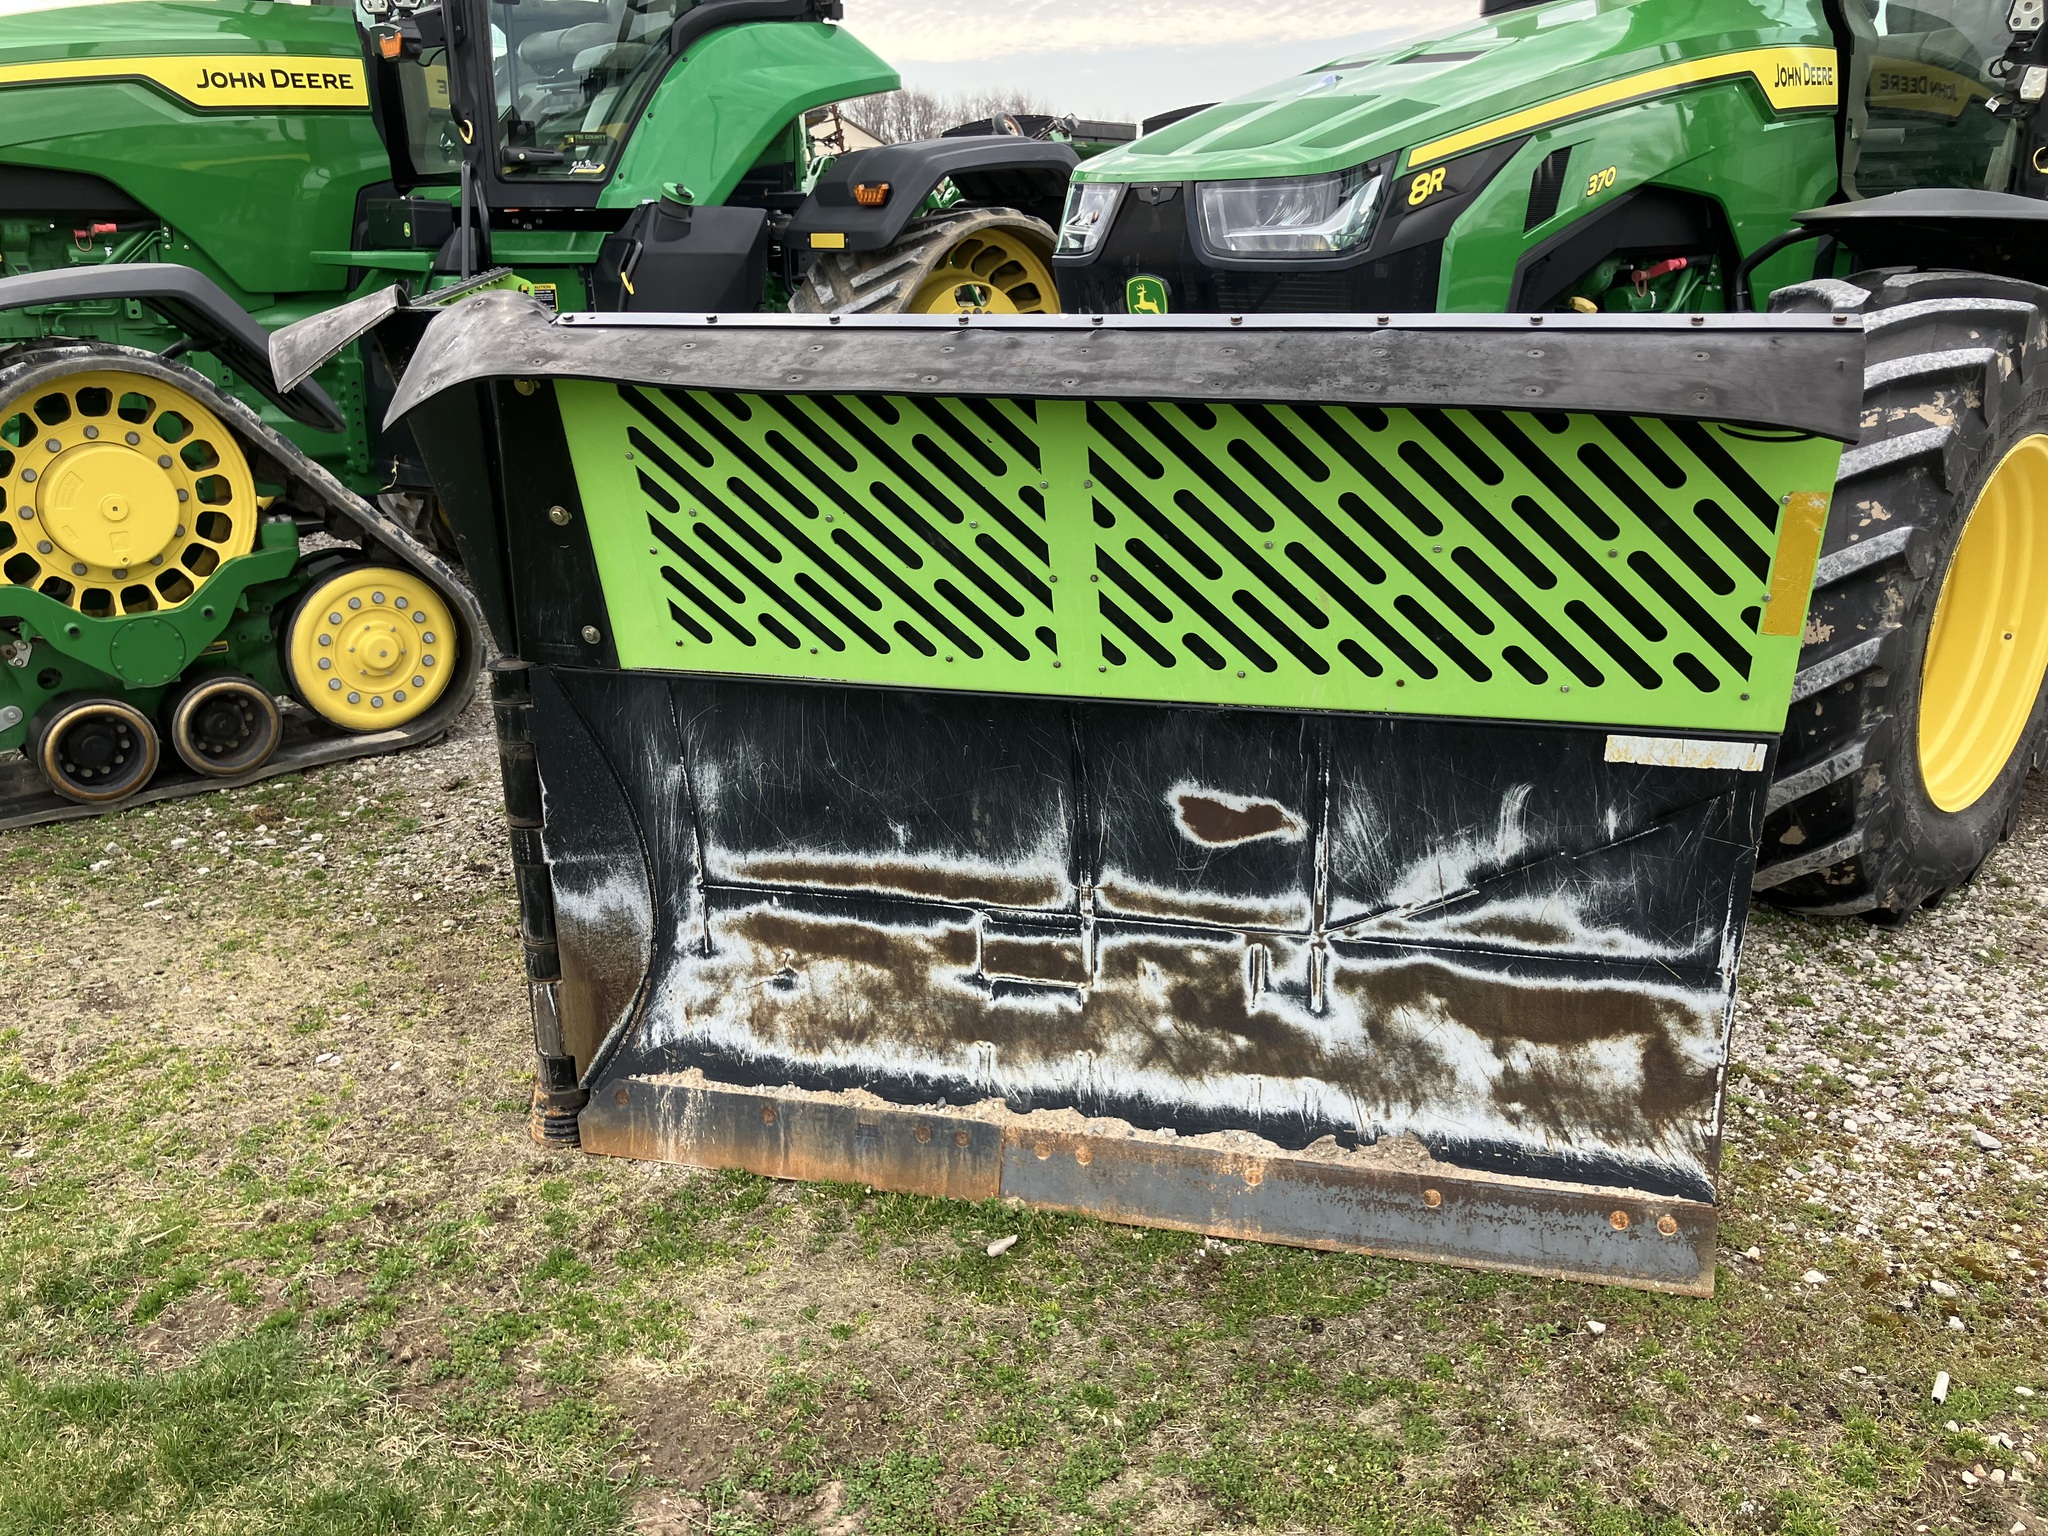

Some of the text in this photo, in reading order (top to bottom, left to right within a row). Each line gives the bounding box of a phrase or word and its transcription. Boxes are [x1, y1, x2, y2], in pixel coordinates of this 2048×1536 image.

[196, 69, 354, 90] JOHN DEERE
[1774, 63, 1833, 88] JOHN DEERE
[1408, 166, 1446, 206] 8R
[1586, 165, 1617, 197] 370
